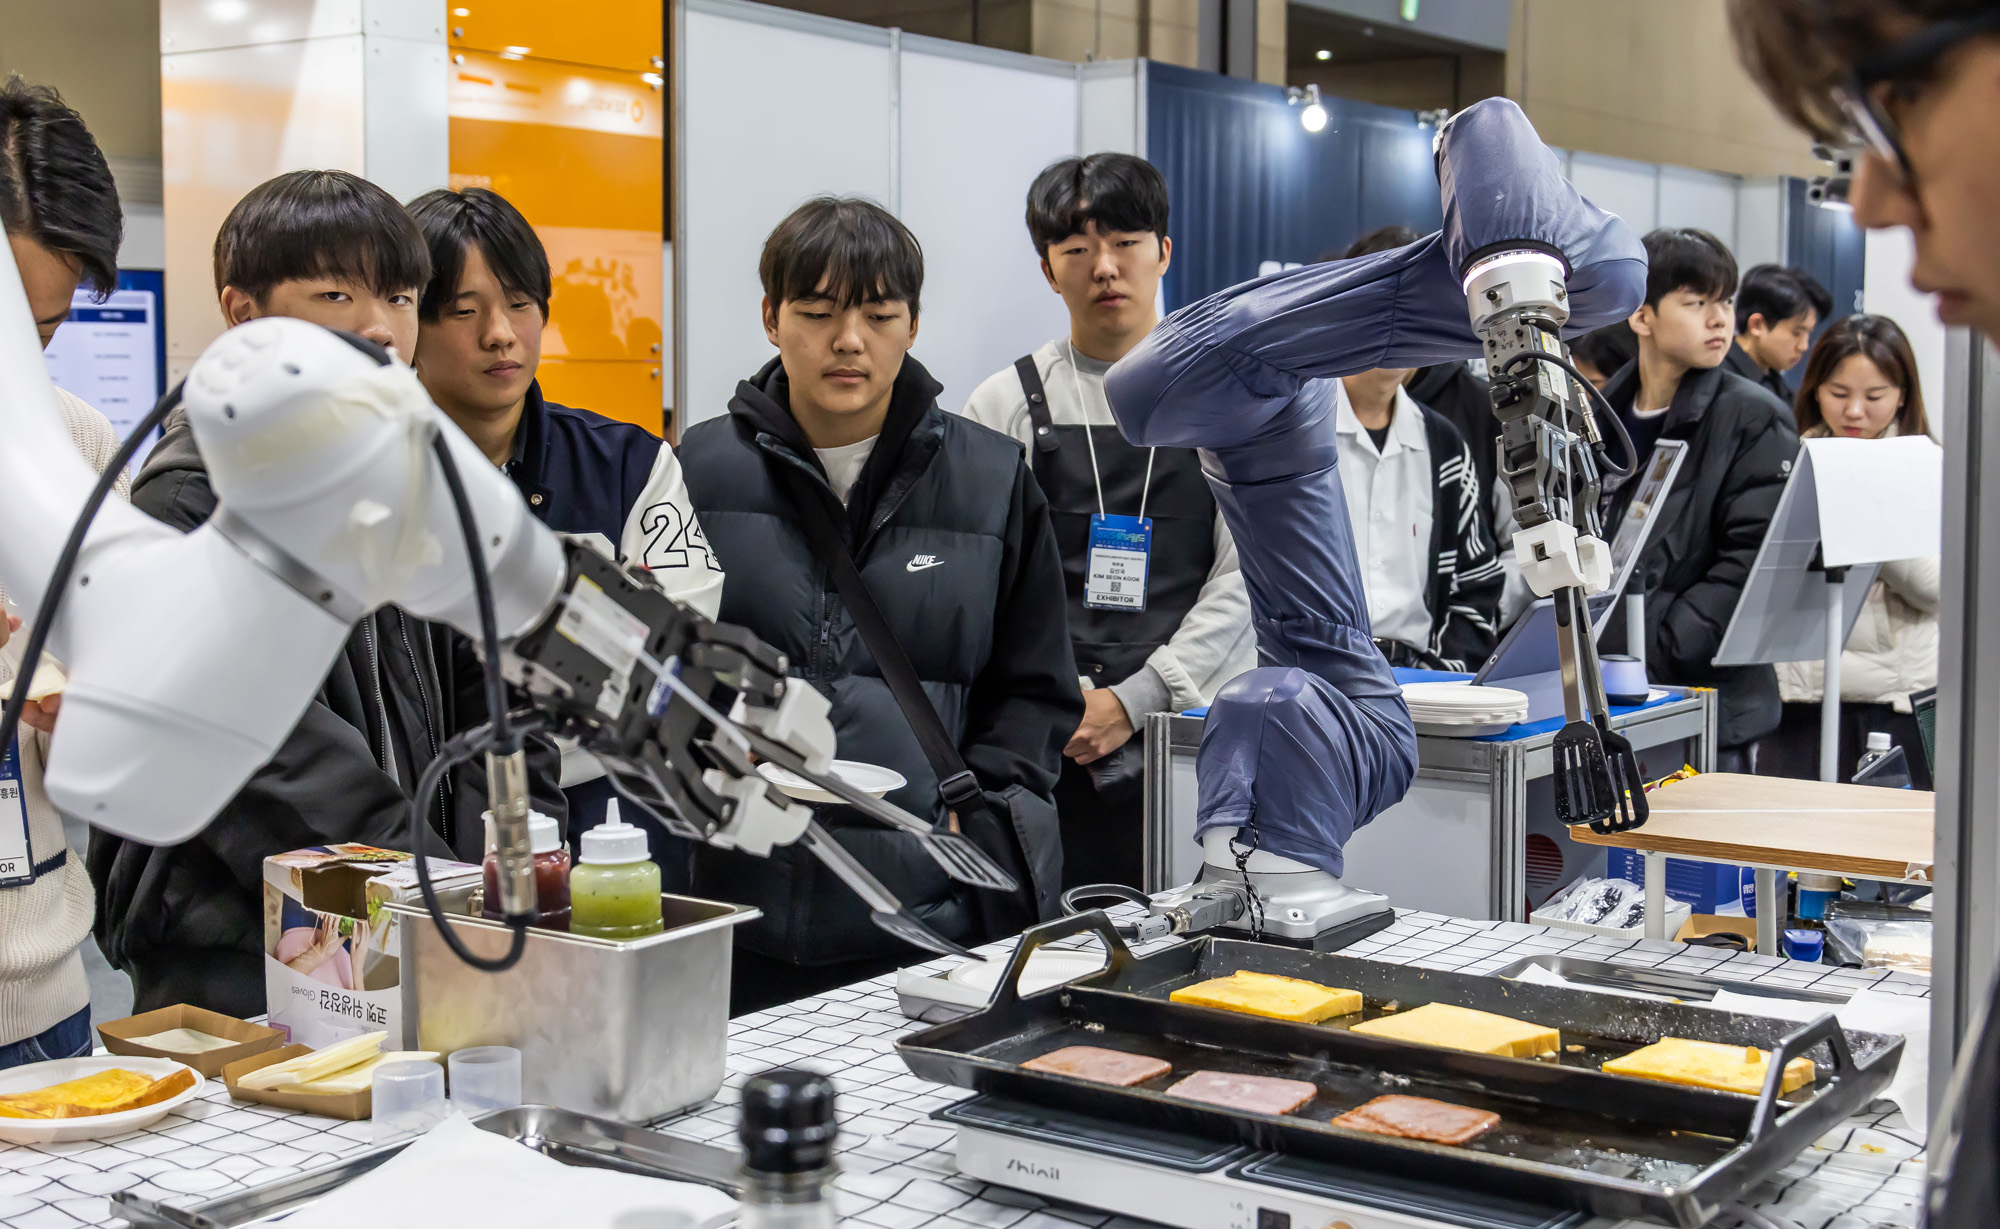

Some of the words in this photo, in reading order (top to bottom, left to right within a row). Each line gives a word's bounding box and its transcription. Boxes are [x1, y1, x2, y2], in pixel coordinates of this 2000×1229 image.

[912, 554, 936, 565] NIKE
[1096, 595, 1134, 603] EXHIBITOR
[291, 986, 315, 1001] Gloves
[319, 989, 364, 1019] 위생장갑
[366, 1002, 388, 1025] 코멧
